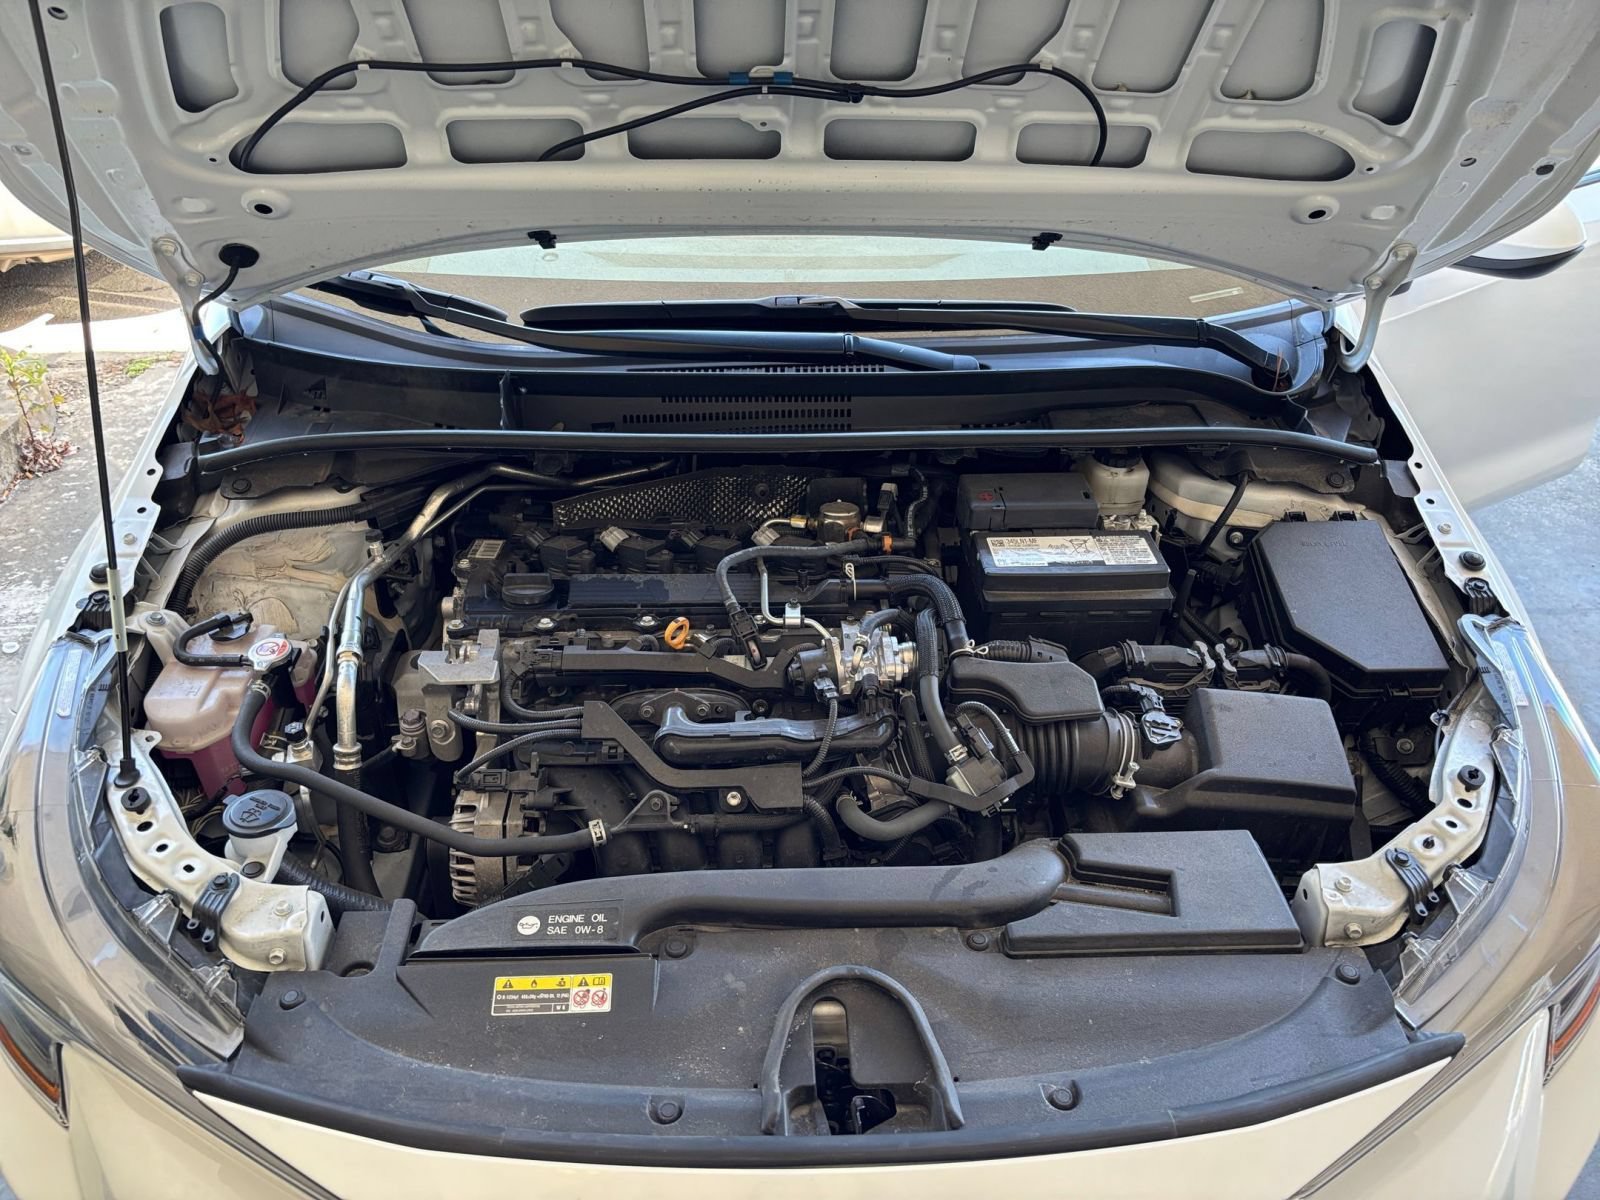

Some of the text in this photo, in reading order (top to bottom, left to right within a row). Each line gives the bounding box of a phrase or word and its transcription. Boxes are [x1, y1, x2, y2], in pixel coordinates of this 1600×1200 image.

[548, 913, 608, 924] ENGINE OIL
[546, 925, 604, 935] SAE 0W-8
